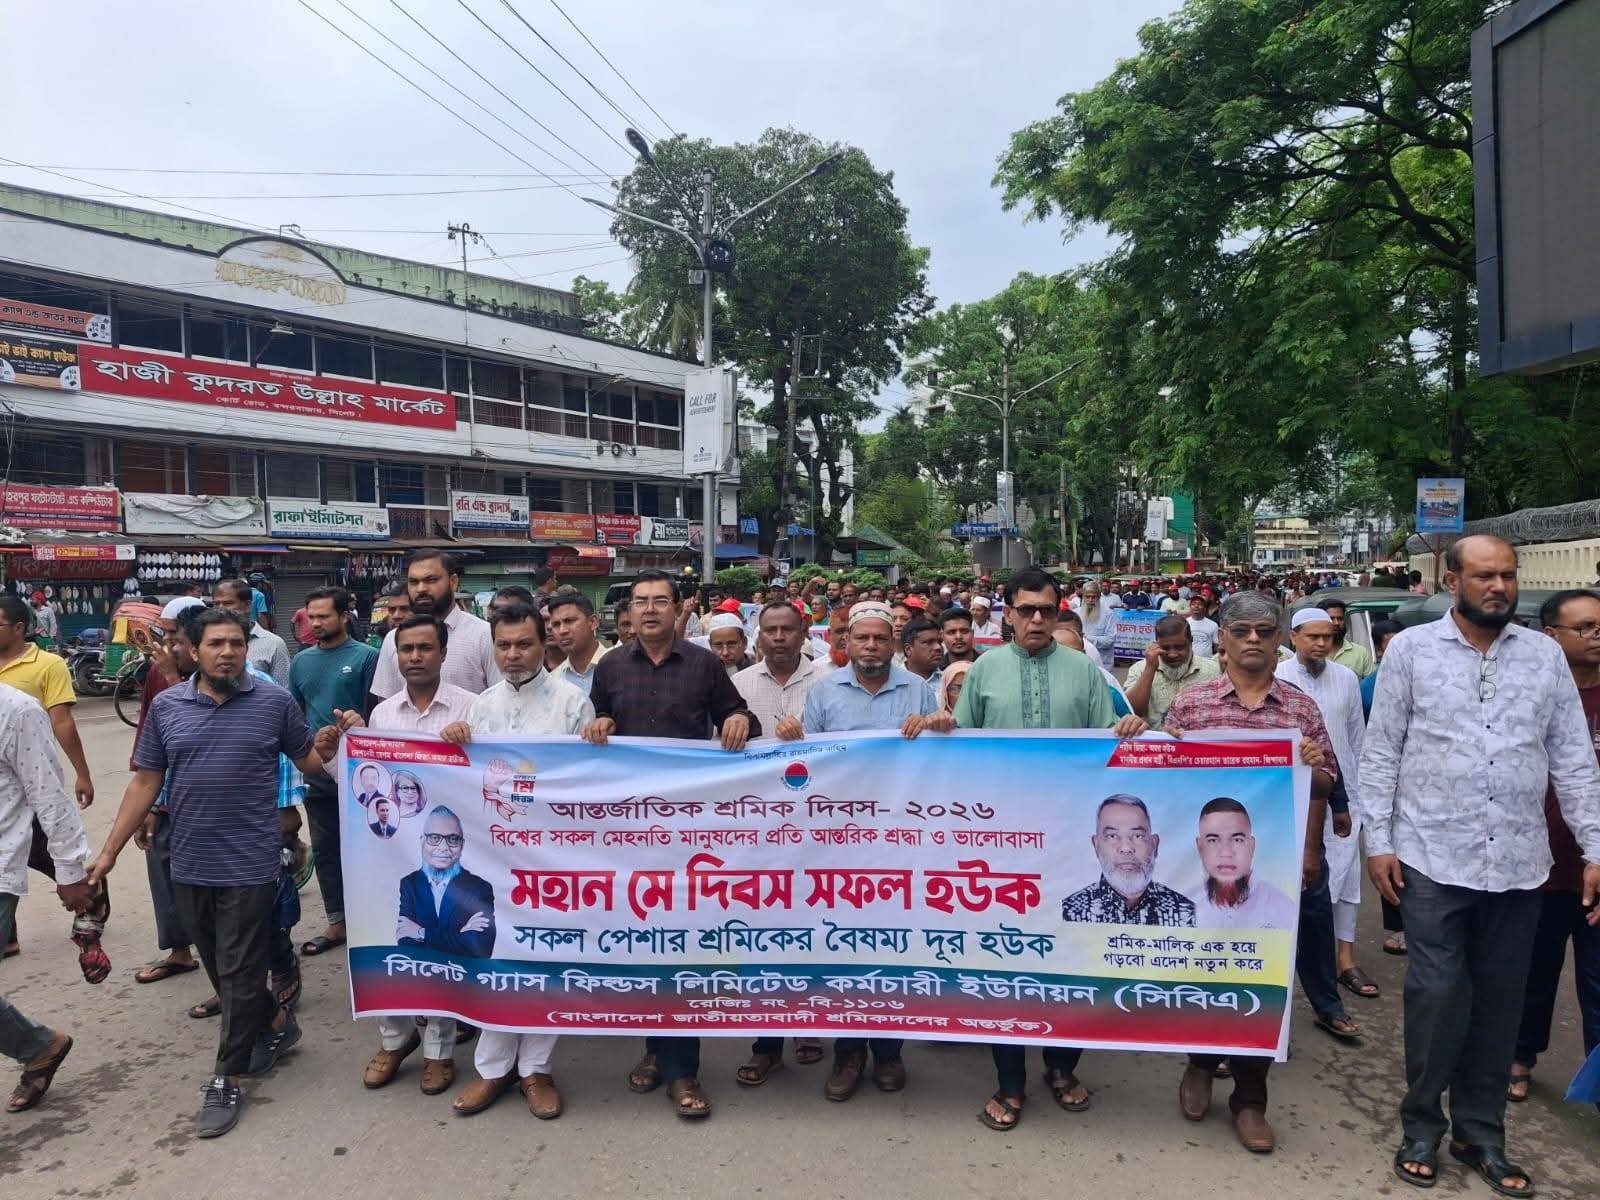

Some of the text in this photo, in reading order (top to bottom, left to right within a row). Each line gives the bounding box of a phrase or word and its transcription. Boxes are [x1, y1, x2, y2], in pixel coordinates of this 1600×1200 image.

[30, 349, 51, 361] ক্যাপ
[91, 360, 176, 384] হাজী
[184, 371, 284, 396] কুদরত
[290, 381, 366, 409] উল্লাহ
[371, 397, 447, 415] মার্কেট
[689, 392, 717, 407] CALL FOR
[455, 496, 470, 511] রনি
[272, 508, 364, 525] রাফা ইমিটেশন
[548, 795, 995, 821] আন্তর্জাতিক শ্রমিক দিবস- ২০২৬
[489, 823, 1046, 850] বিশ্বের সকল মেহনতি মানুষদের প্রতি আন্তরিক শ্রদ্ধা ও ভালোবাসা
[511, 852, 1042, 921] মহান মে দিবস সফল হউক
[514, 918, 1056, 964] সকল পেশার শ্রমিকের বৈষম্য দূর হউক
[1107, 934, 1257, 954] শ্রমিক-মালিক এক হয়ে
[1104, 953, 1264, 973] গড়বো এদেশ নতুন করে
[382, 953, 1261, 1017] সিলেট গ্যাস ফিল্ডস লিমিটেড কর্মচারী ইউনিয়ন (সিবিএ)
[687, 996, 752, 1010] রেজিঃ
[760, 998, 789, 1009] নং
[547, 1011, 663, 1024] (বাংলাদেশ
[671, 1010, 819, 1024] জাতীয়তাবাদী
[826, 1012, 950, 1027] শ্রমিকদলের
